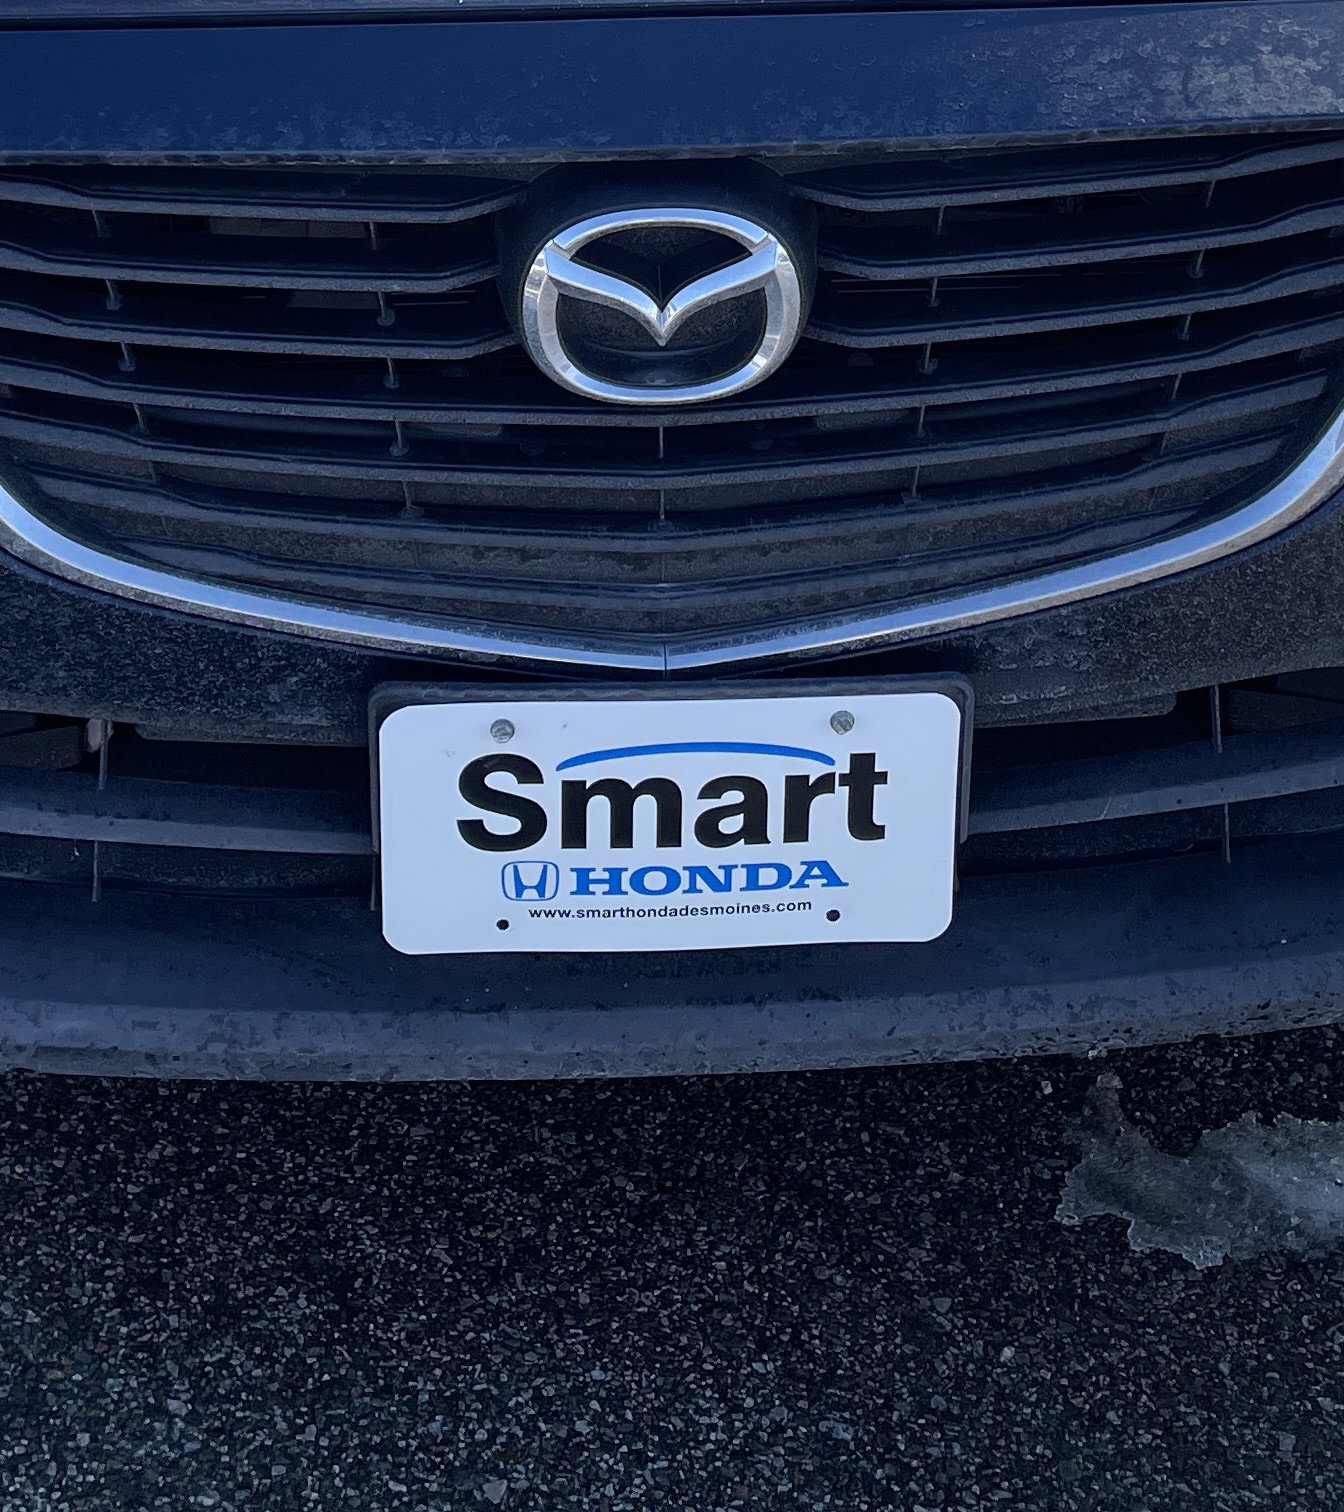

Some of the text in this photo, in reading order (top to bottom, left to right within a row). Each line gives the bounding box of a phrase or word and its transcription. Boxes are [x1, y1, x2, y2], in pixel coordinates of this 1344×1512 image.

[456, 752, 888, 852] Smart
[569, 859, 849, 896] HONDA
[528, 899, 813, 920] www.smarthondadesmoines.com
